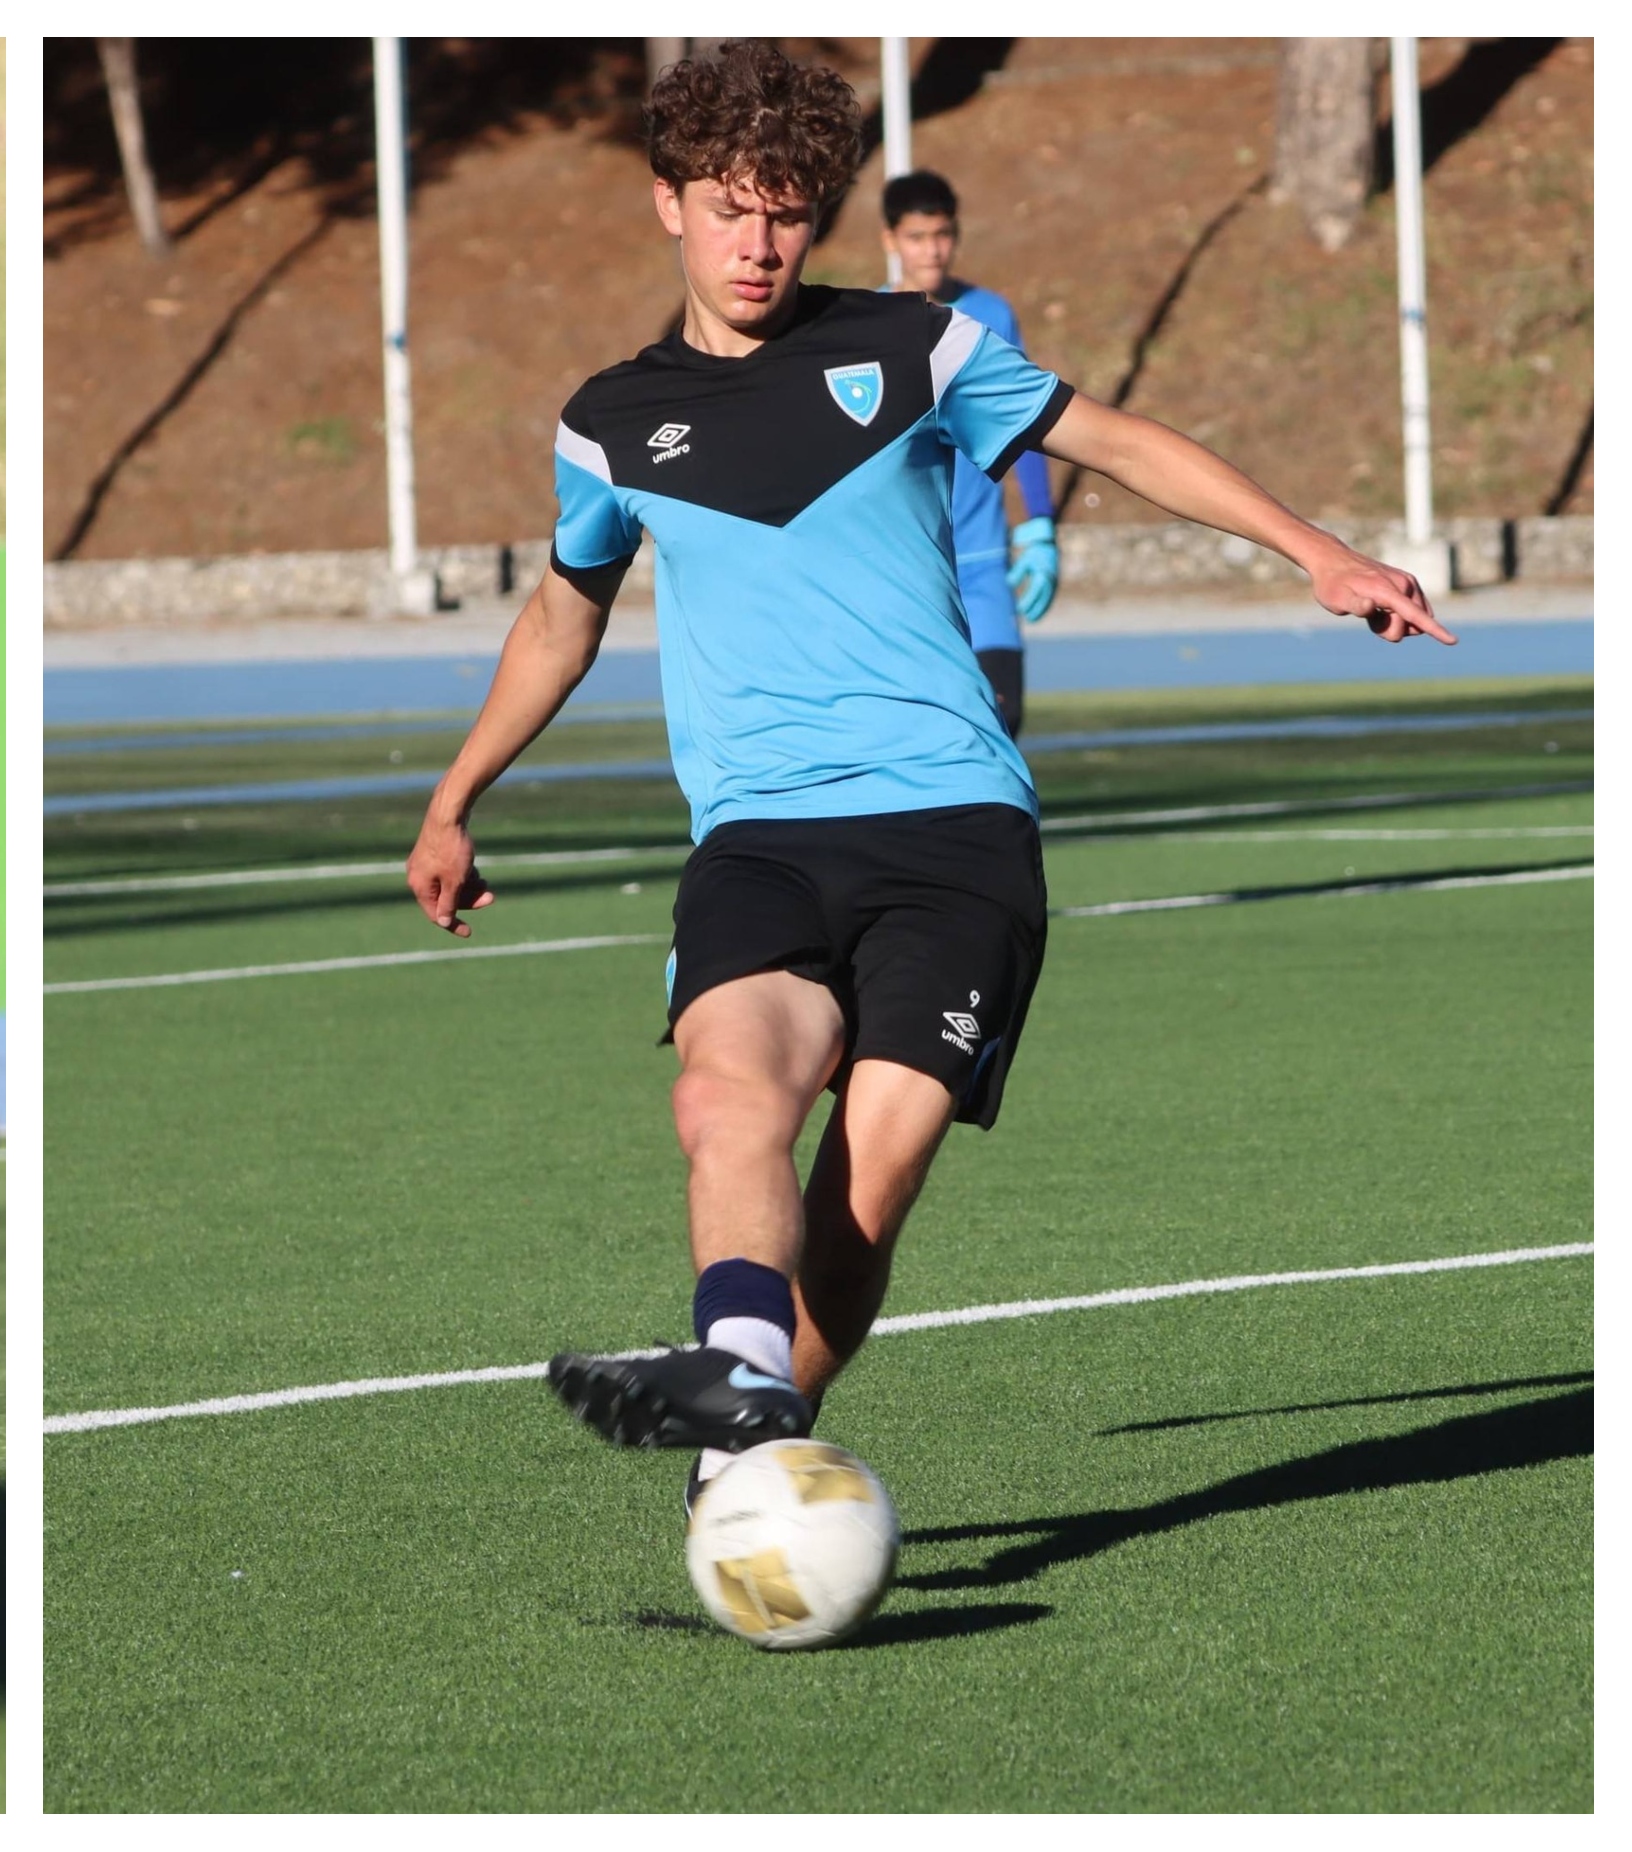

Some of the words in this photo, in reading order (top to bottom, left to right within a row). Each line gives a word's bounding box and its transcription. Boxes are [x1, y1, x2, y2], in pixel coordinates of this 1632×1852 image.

[652, 443, 690, 464] umbro
[969, 989, 980, 1008] 9
[941, 1028, 974, 1056] umbro
